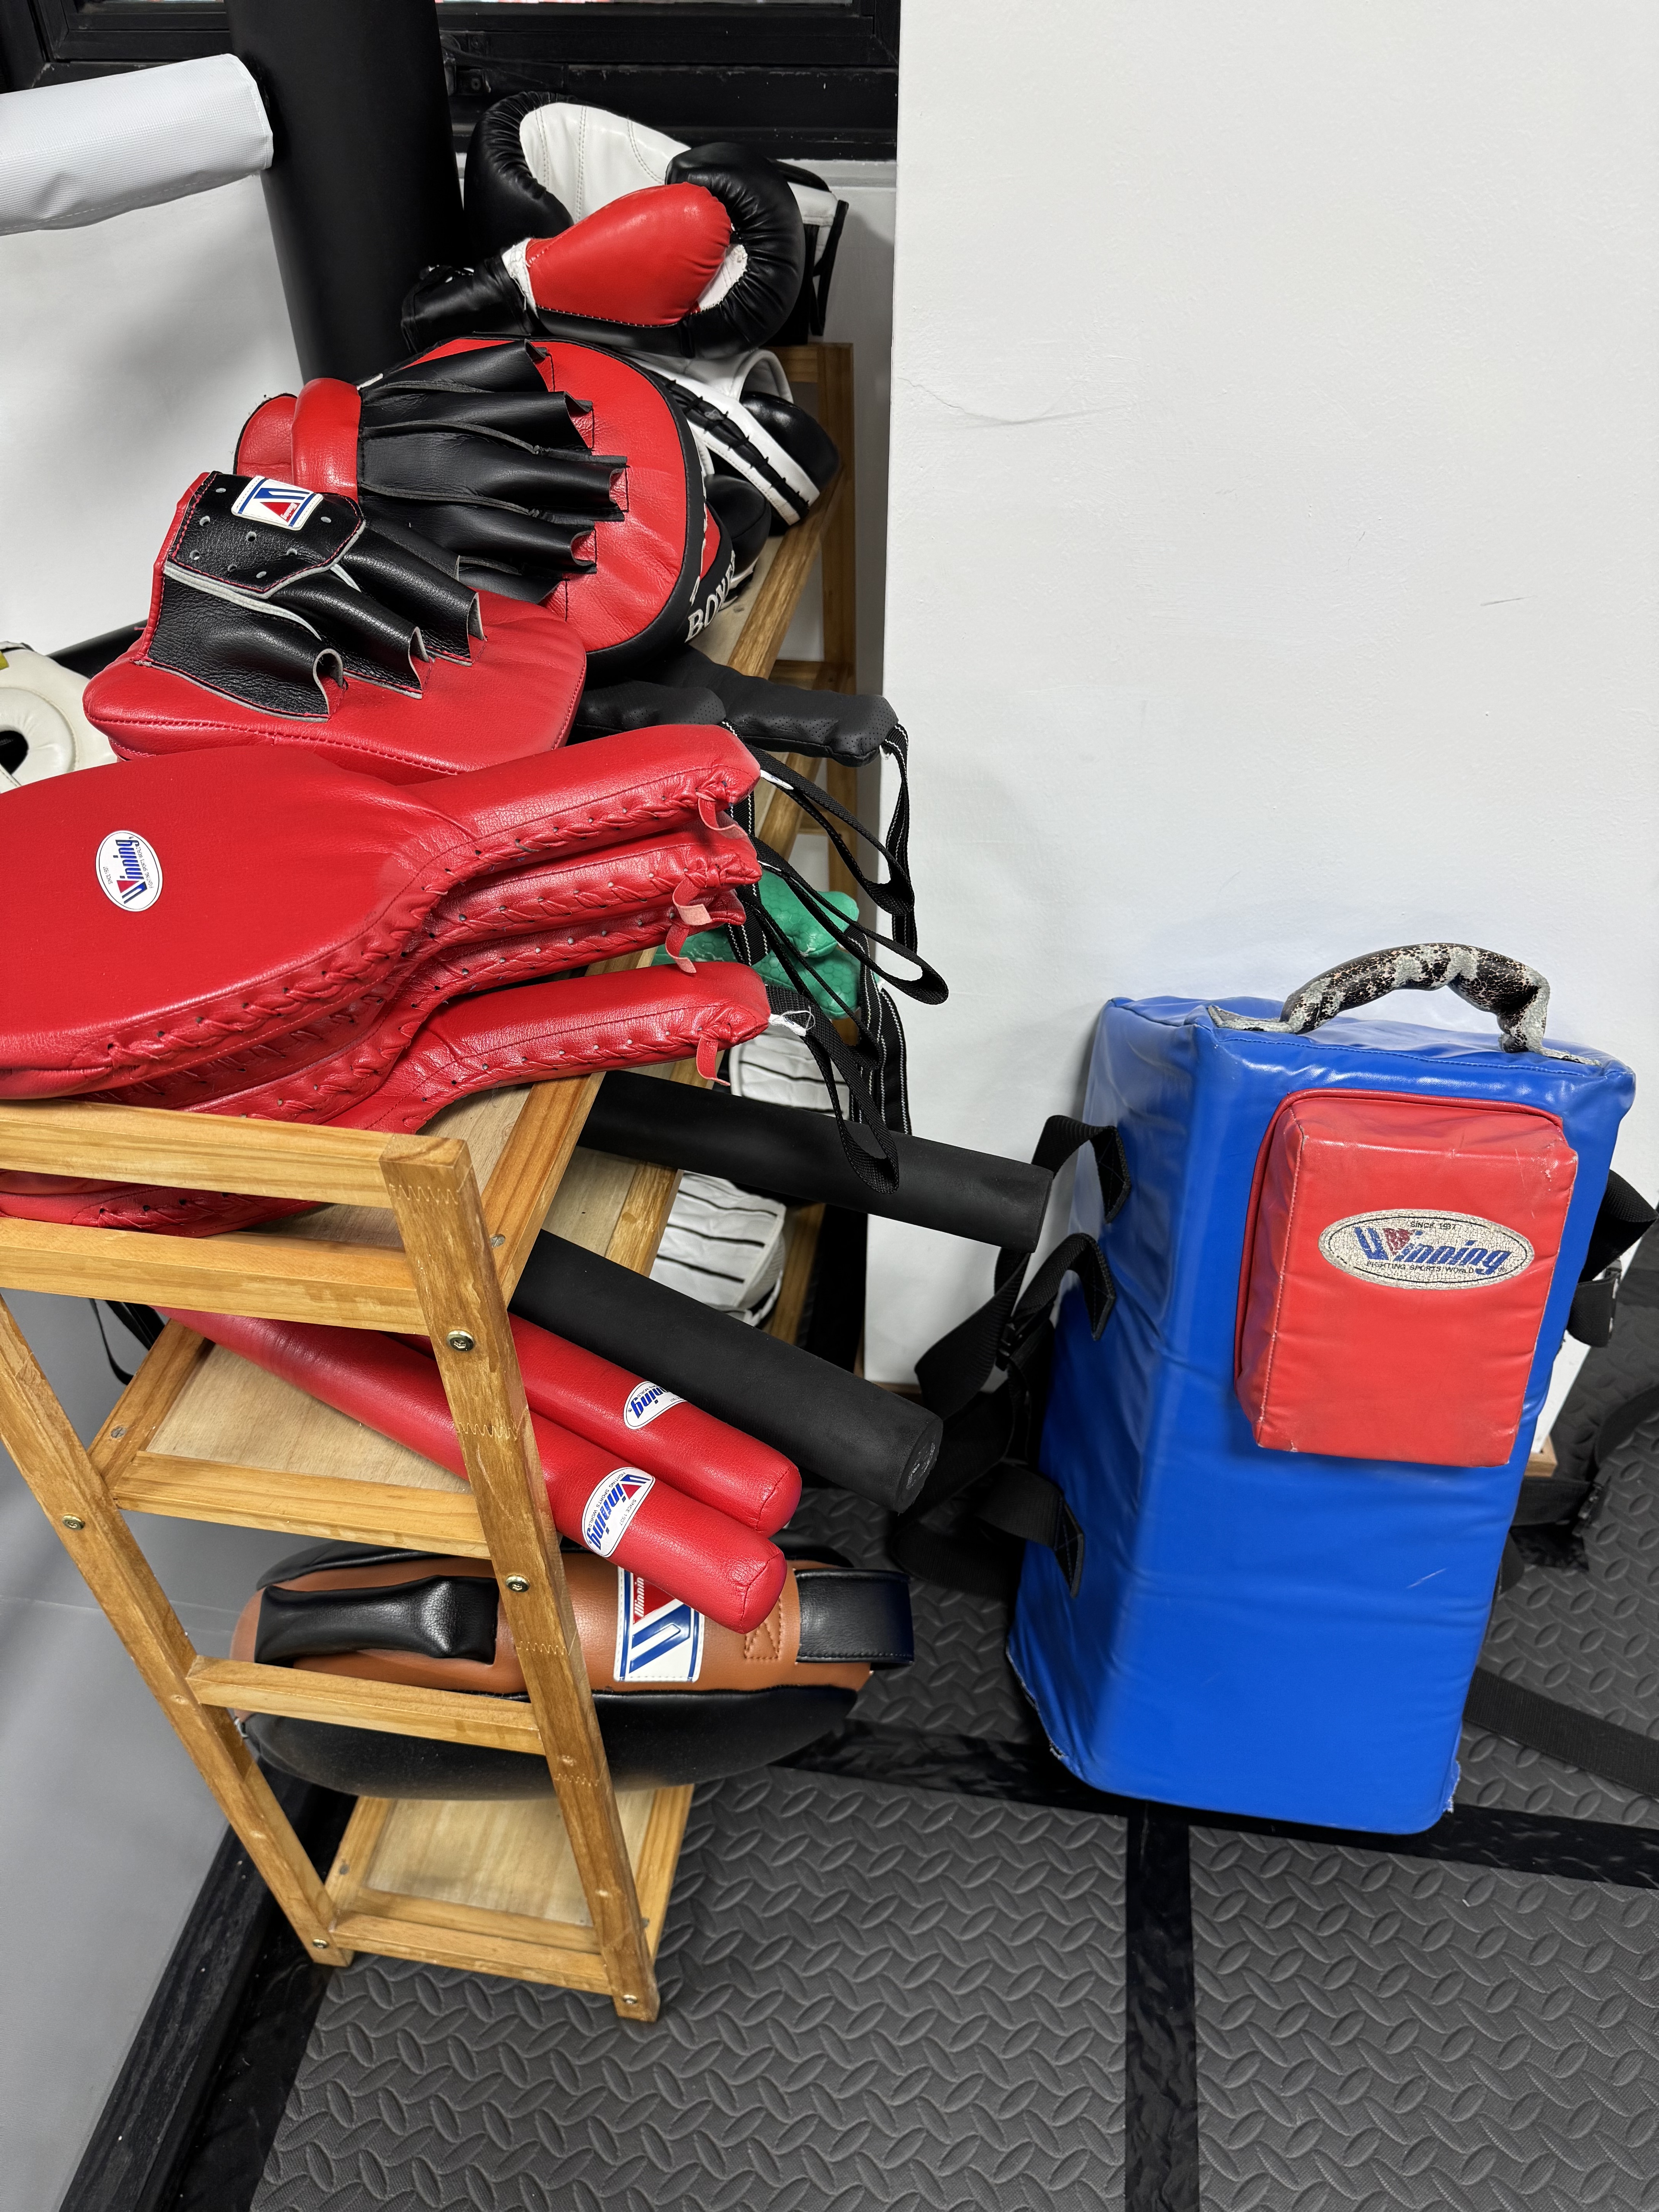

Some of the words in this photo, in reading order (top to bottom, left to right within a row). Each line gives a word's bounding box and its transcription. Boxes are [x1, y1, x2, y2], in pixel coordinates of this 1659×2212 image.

[280, 502, 298, 520] Winning
[113, 839, 148, 904] Winning
[1354, 1226, 1512, 1275] Winning
[1366, 1261, 1406, 1270] FIGHTING
[609, 1472, 626, 1488] FIGHTING
[596, 1489, 610, 1508] SPORTS
[625, 1499, 637, 1514] SINCE
[587, 1474, 651, 1551] Winning
[588, 1510, 598, 1528] WORLD
[634, 1577, 644, 1618] Winnin
